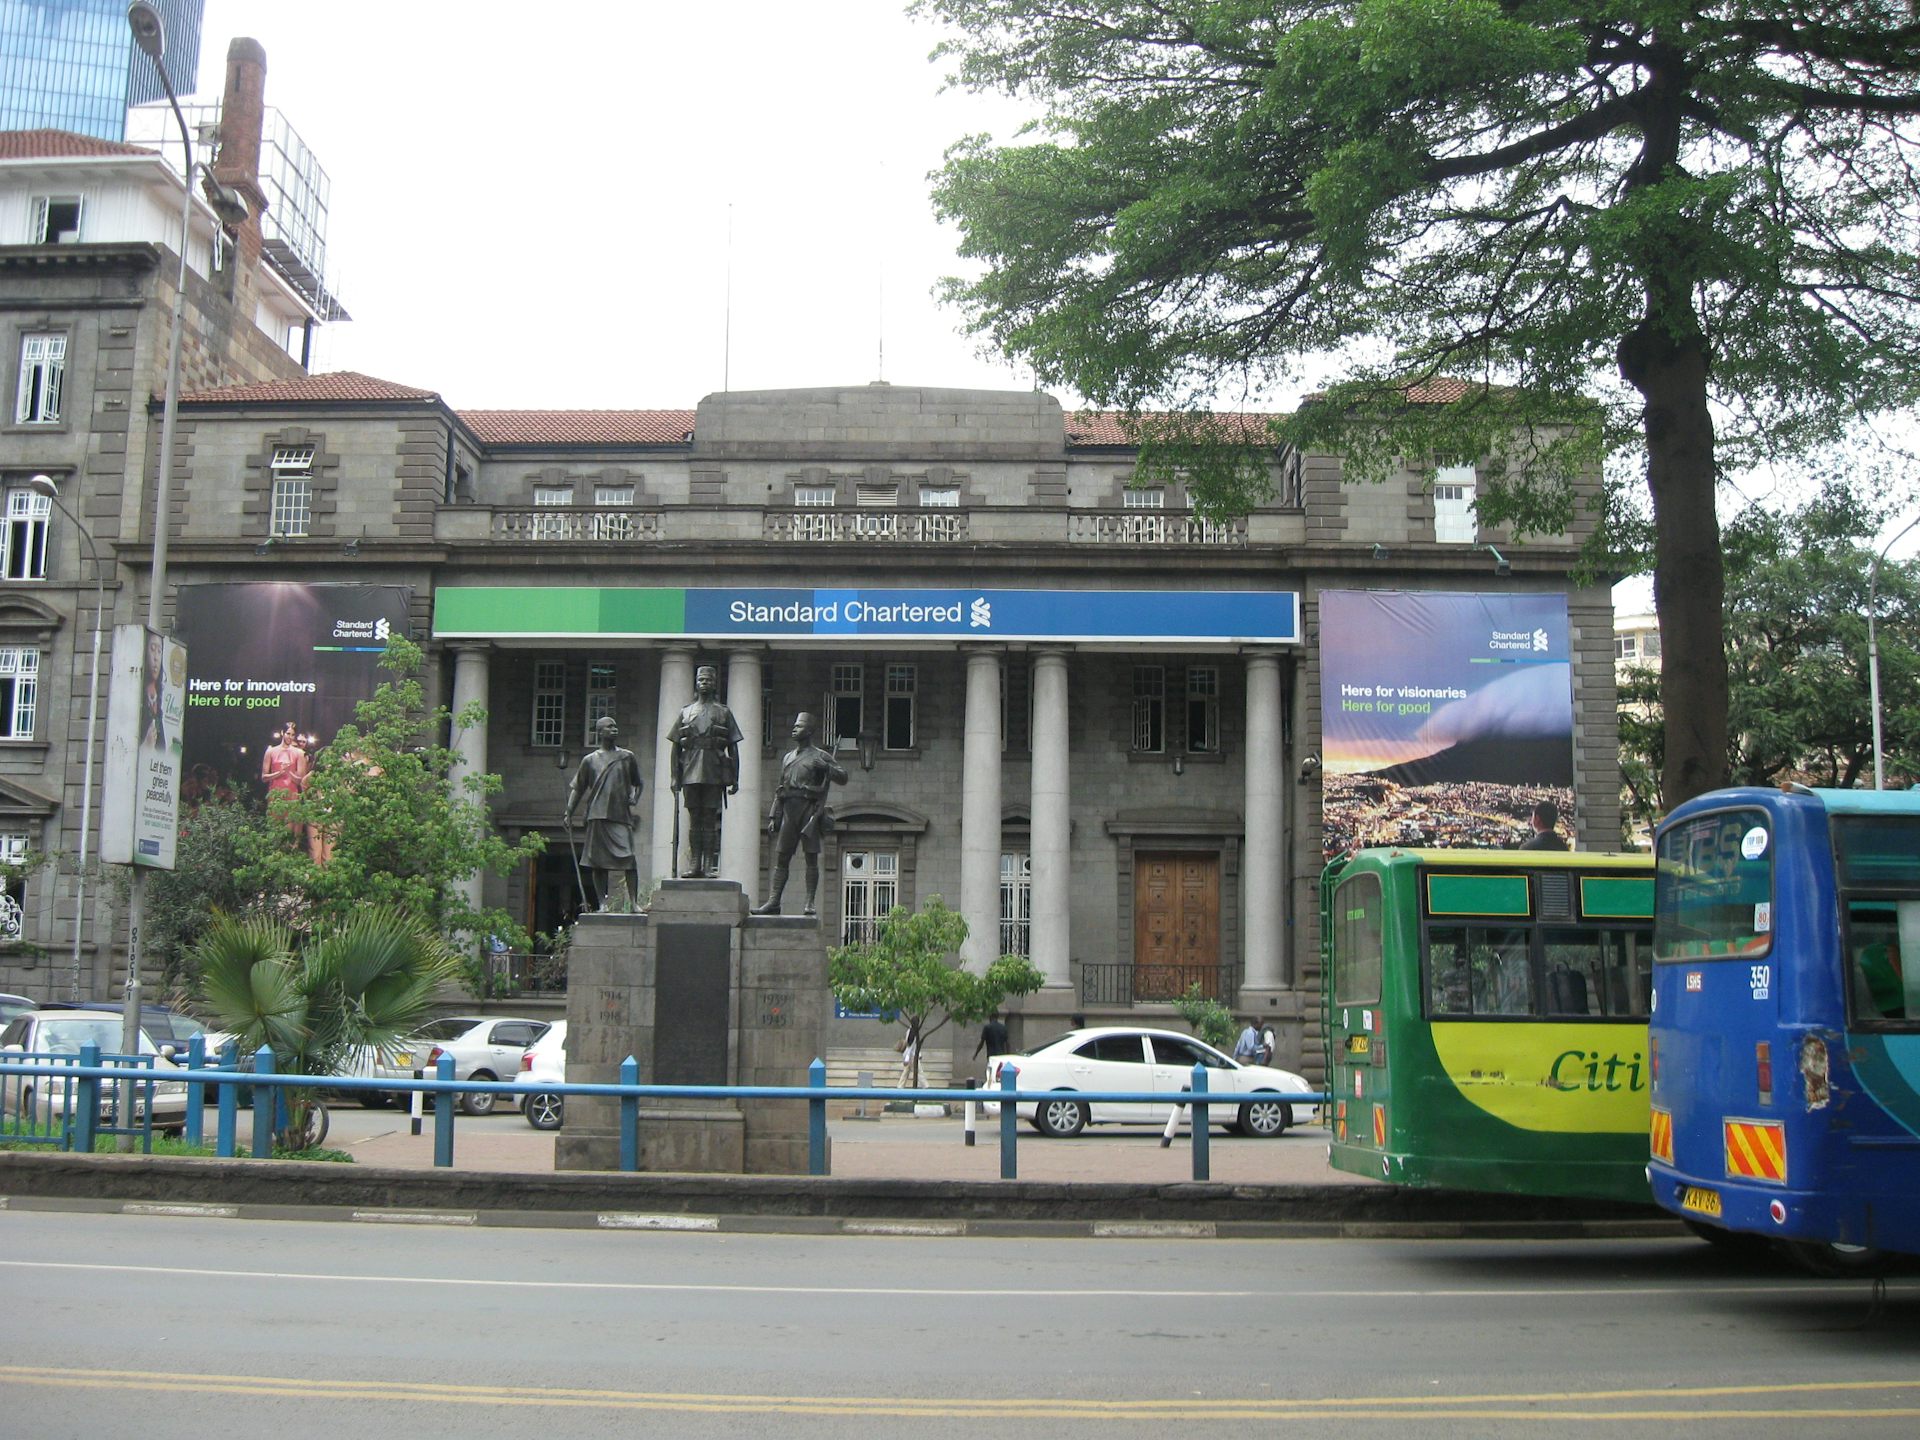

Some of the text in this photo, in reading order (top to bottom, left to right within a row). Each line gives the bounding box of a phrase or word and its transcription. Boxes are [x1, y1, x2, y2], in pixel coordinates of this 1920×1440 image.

[729, 601, 962, 623] Standard Chartered
[336, 620, 374, 629] Standard
[332, 629, 373, 638] Chartered
[1492, 631, 1531, 640] Standard
[1489, 640, 1531, 649] Chartered
[189, 678, 317, 693] Here for innovators
[1341, 684, 1468, 699] Here for visionaries
[189, 693, 281, 709] Here for good
[1341, 699, 1431, 716] Here for good
[149, 759, 173, 777] Let them
[152, 774, 169, 790] grieve
[1750, 965, 1770, 988] 350
[1550, 1050, 1645, 1092] Citi
